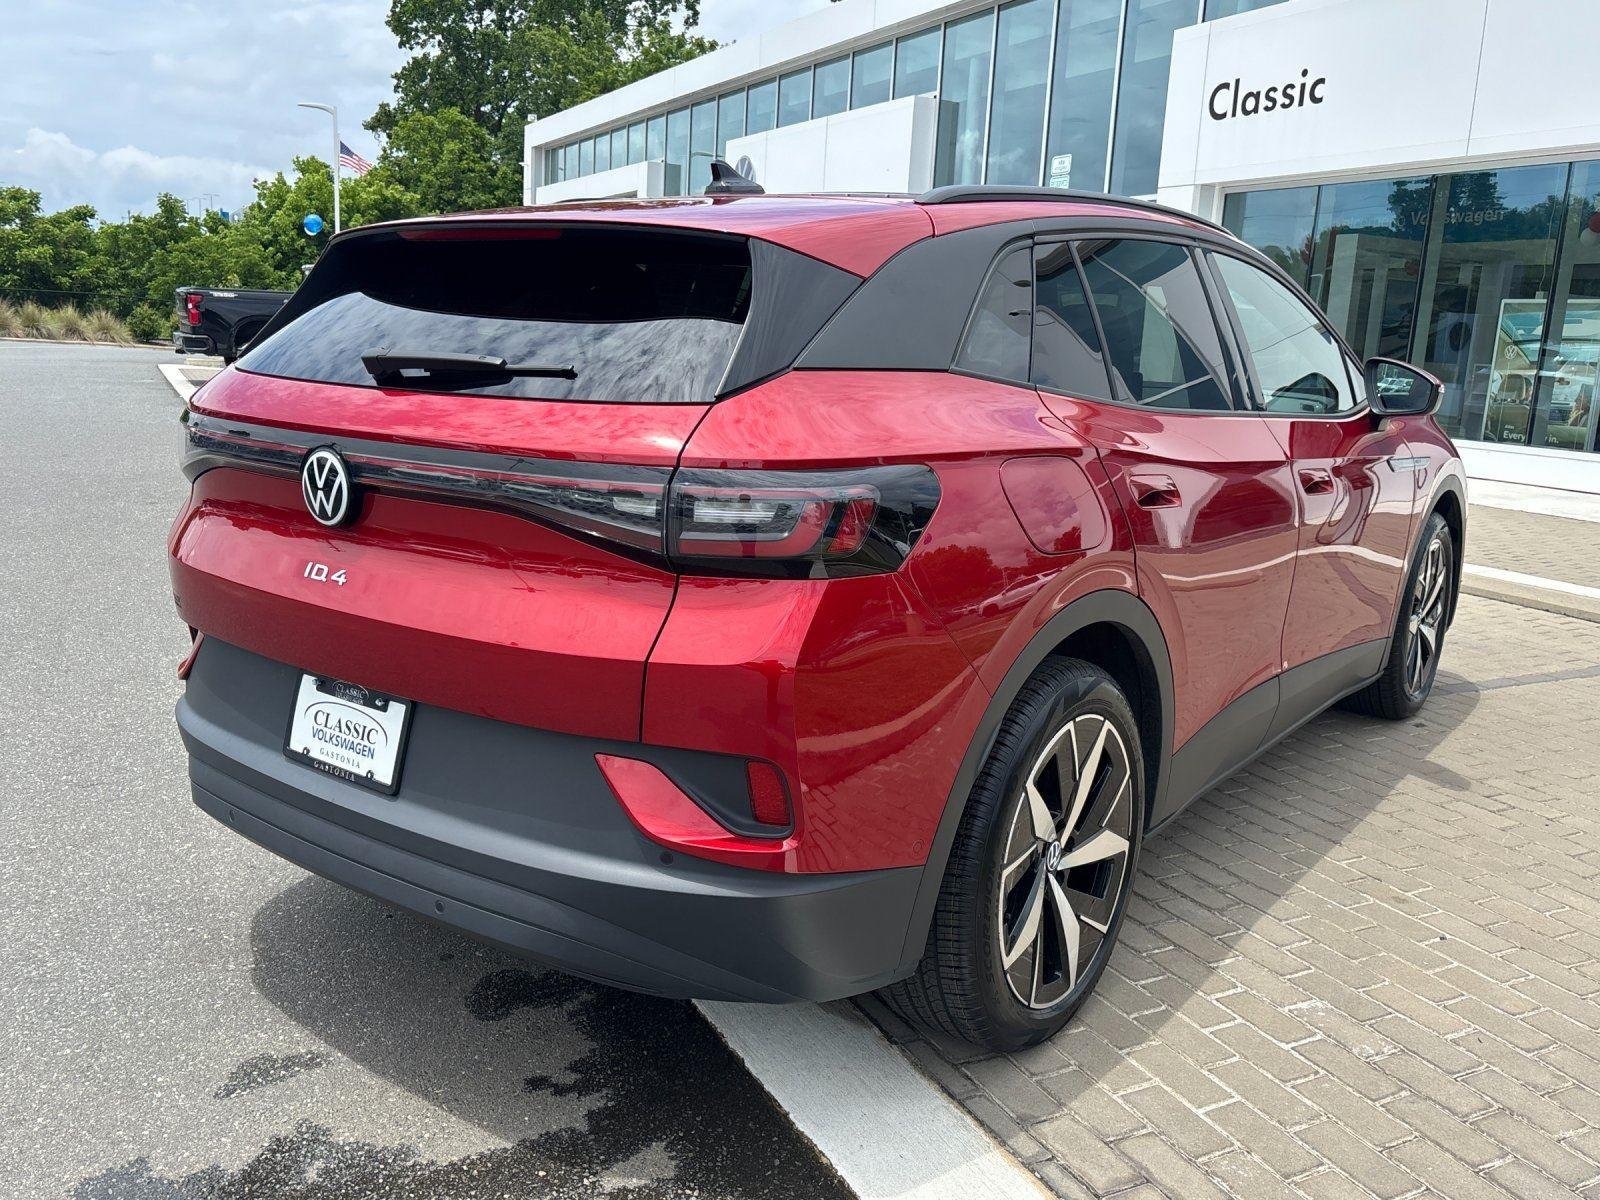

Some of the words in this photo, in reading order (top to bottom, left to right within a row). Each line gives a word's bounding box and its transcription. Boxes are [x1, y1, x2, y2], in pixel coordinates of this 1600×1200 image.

[1208, 68, 1326, 121] Classic
[336, 683, 365, 699] CLASSIC
[314, 709, 378, 745] CLASSIC
[312, 726, 375, 760] VOLKSWAGEN
[314, 761, 355, 781] GASTONIA
[320, 747, 360, 769] GASTONIA
